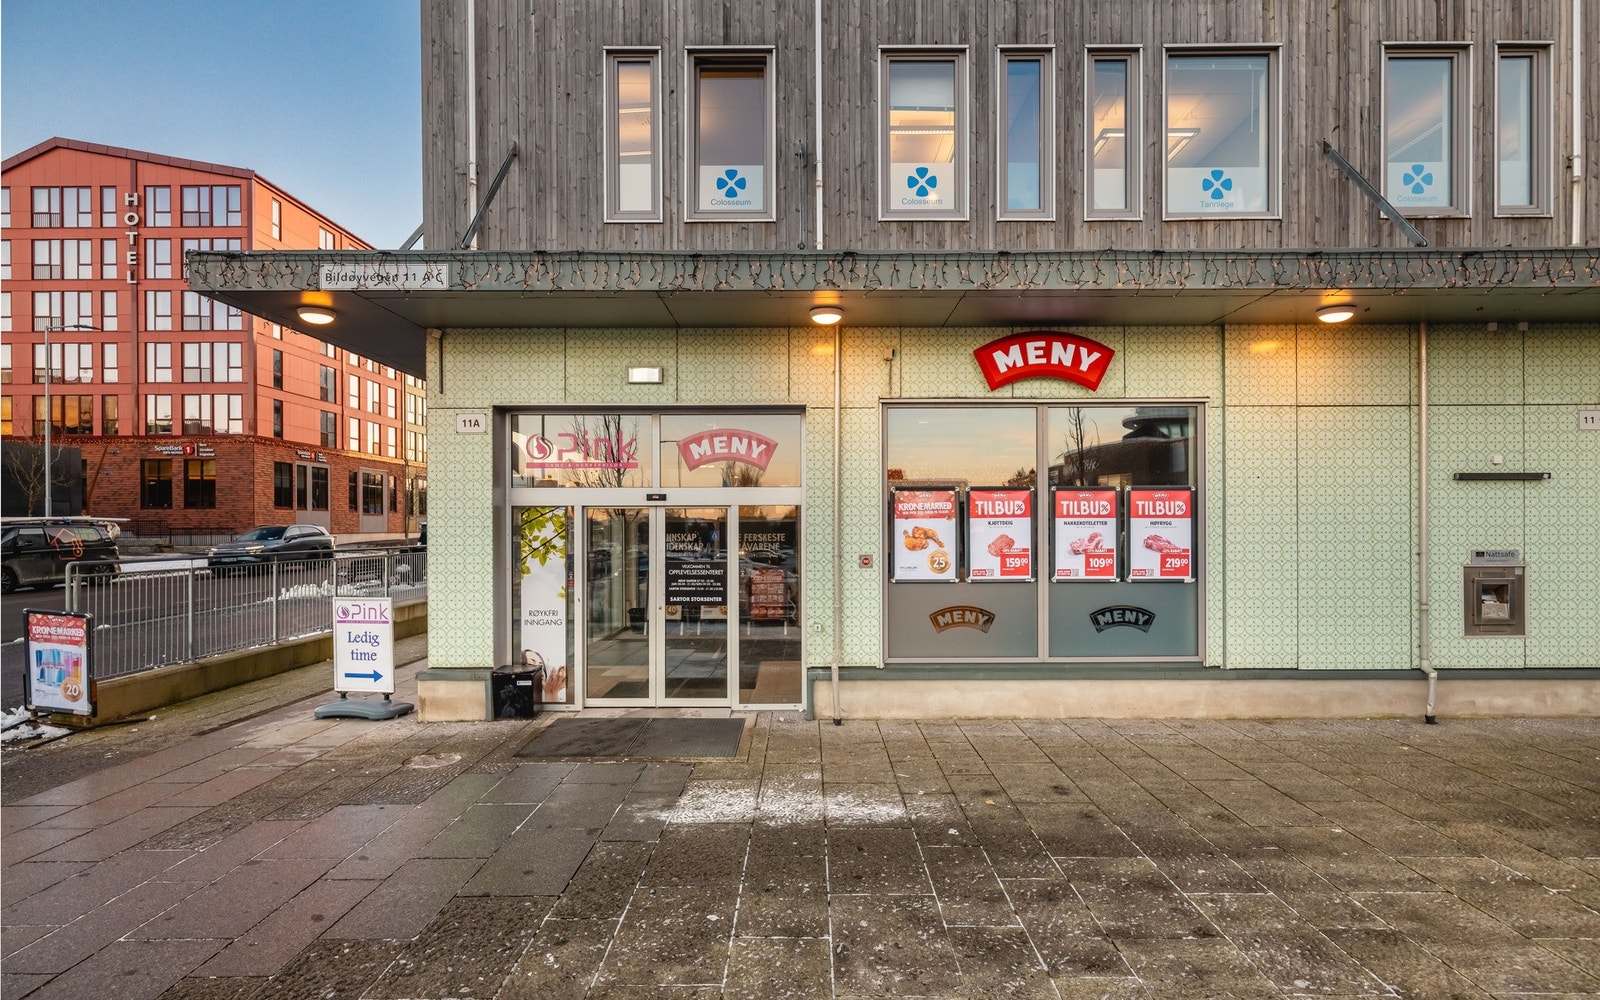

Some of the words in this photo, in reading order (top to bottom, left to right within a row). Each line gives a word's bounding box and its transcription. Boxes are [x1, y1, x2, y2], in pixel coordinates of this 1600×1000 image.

[710, 198, 752, 206] Colosseum
[901, 198, 943, 206] Colosseum
[1396, 194, 1438, 203] Colosseum
[1200, 201, 1234, 210] Tannlege
[124, 192, 139, 284] HOTEL
[325, 272, 398, 284] Bildøyvegen
[403, 272, 416, 282] 11
[992, 341, 1102, 374] MENY
[462, 419, 480, 428] 11A
[557, 429, 638, 461] Pink
[689, 436, 767, 460] MENY
[898, 501, 953, 511] KRONEMARKED
[744, 533, 786, 542] FERSKESTE
[738, 542, 780, 551] ÅVARENE
[933, 557, 946, 568] 25
[351, 603, 388, 620] Pink
[528, 609, 559, 617] RØYKFRI
[1096, 609, 1150, 626] MENY
[524, 618, 563, 626] INNGANG
[936, 610, 990, 628] MENY
[32, 625, 85, 637] KRONEMARKED
[347, 631, 380, 647] Ledig
[350, 648, 378, 662] time
[66, 684, 79, 696] 20
